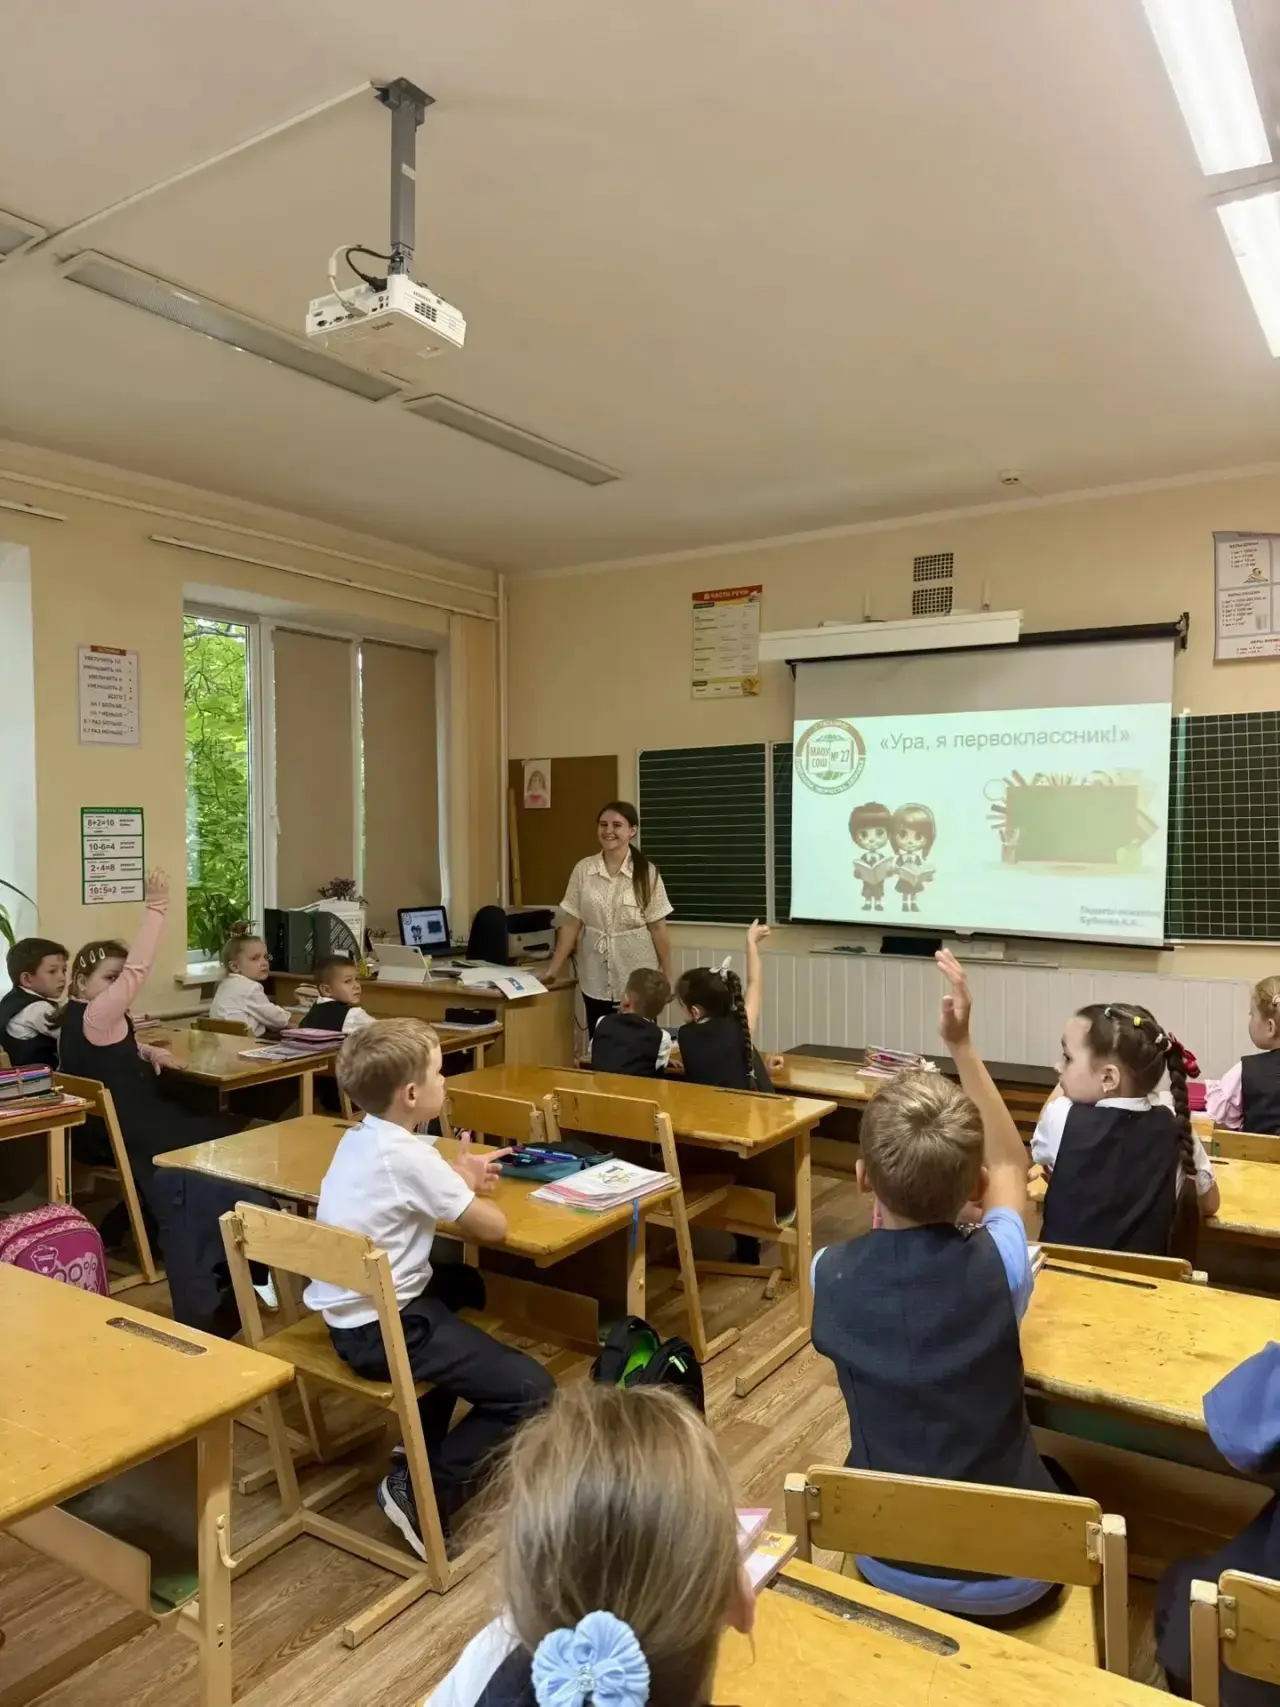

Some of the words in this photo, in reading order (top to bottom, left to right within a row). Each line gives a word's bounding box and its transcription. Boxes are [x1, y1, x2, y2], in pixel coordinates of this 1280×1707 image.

[880, 731, 930, 754] «Ура,
[936, 736, 947, 749] я
[953, 725, 1130, 751] первоклассник!»
[840, 749, 850, 763] 27
[812, 758, 828, 768] СОШ
[88, 819, 115, 827] 8+2=10
